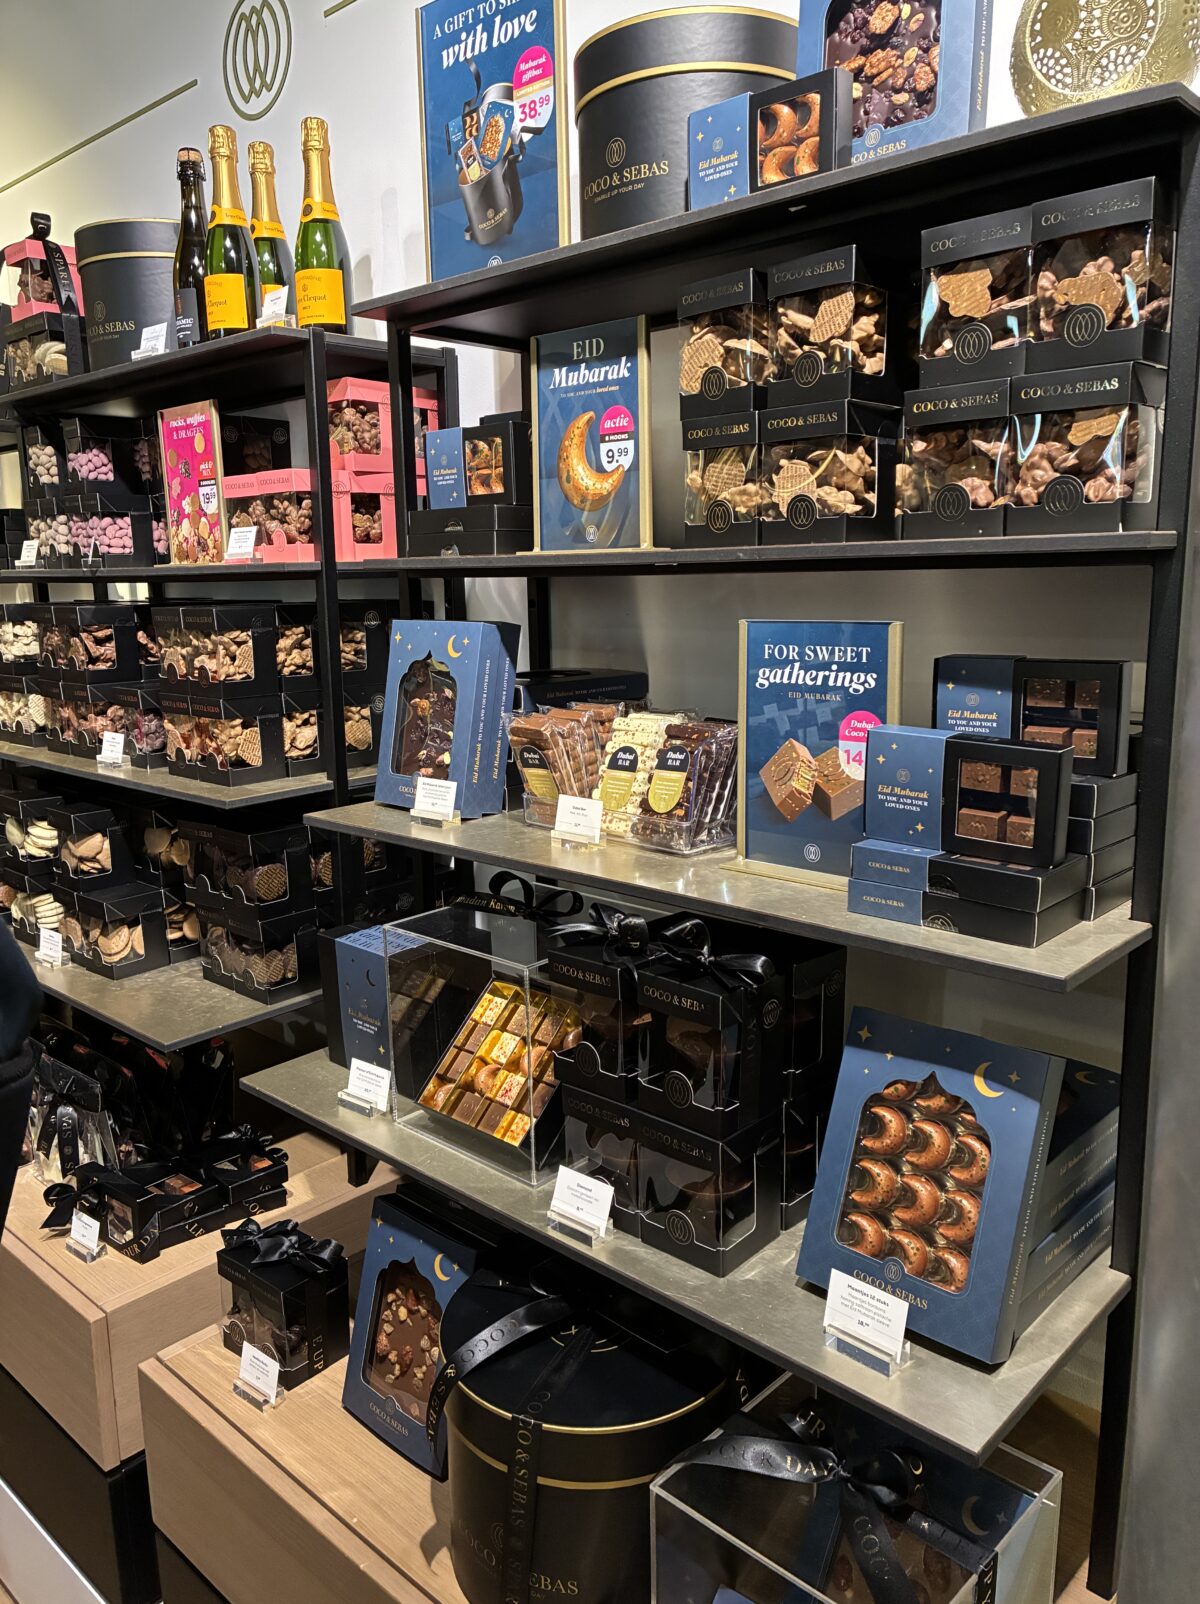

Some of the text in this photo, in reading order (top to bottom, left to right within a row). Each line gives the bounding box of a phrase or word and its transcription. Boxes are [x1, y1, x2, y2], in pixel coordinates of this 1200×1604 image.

[433, 24, 442, 40] A
[444, 8, 475, 34] GIFT
[477, 0, 496, 19] TO
[442, 9, 538, 70] with love
[518, 54, 547, 73] Mubarak
[522, 67, 543, 83] giftbox
[699, 150, 739, 170] Eid Mubarak
[851, 152, 868, 165] CO
[876, 139, 907, 157] SEBAS
[584, 161, 669, 200] COCO & SEBAS
[633, 182, 645, 192] DAY
[774, 259, 845, 284] COCO & SEBAS
[105, 320, 136, 334] SEBAS
[573, 337, 605, 361] EID
[549, 356, 632, 390] Mubarak
[1021, 377, 1120, 400] COCO & SEBAS
[913, 393, 999, 414] COCO & SEBAS
[604, 413, 630, 429] actie
[767, 412, 838, 430] COCO & SEBAS
[610, 433, 629, 441] MOONS
[688, 423, 750, 440] COCO & SEBAS
[763, 644, 871, 663] FOR SWEET
[755, 662, 878, 695] gatherings
[788, 691, 842, 702] EID MUBARAK
[948, 709, 999, 720] Eid Mubarak
[845, 728, 865, 738] Coco
[850, 719, 875, 730] Dubai
[617, 752, 636, 760] Dubai
[667, 752, 686, 760] Dubai
[877, 784, 929, 799] Eid Mubarak
[885, 801, 921, 812] LOVED ONES
[912, 798, 929, 807] YOUR
[553, 962, 612, 987] COCO & SEBAS
[643, 985, 705, 1012] COCO & SEBA
[853, 1269, 928, 1310] COCO & SEBAS
[515, 1448, 530, 1463] &
[786, 1455, 834, 1476] DAY
[512, 1466, 529, 1529] SEBAS
